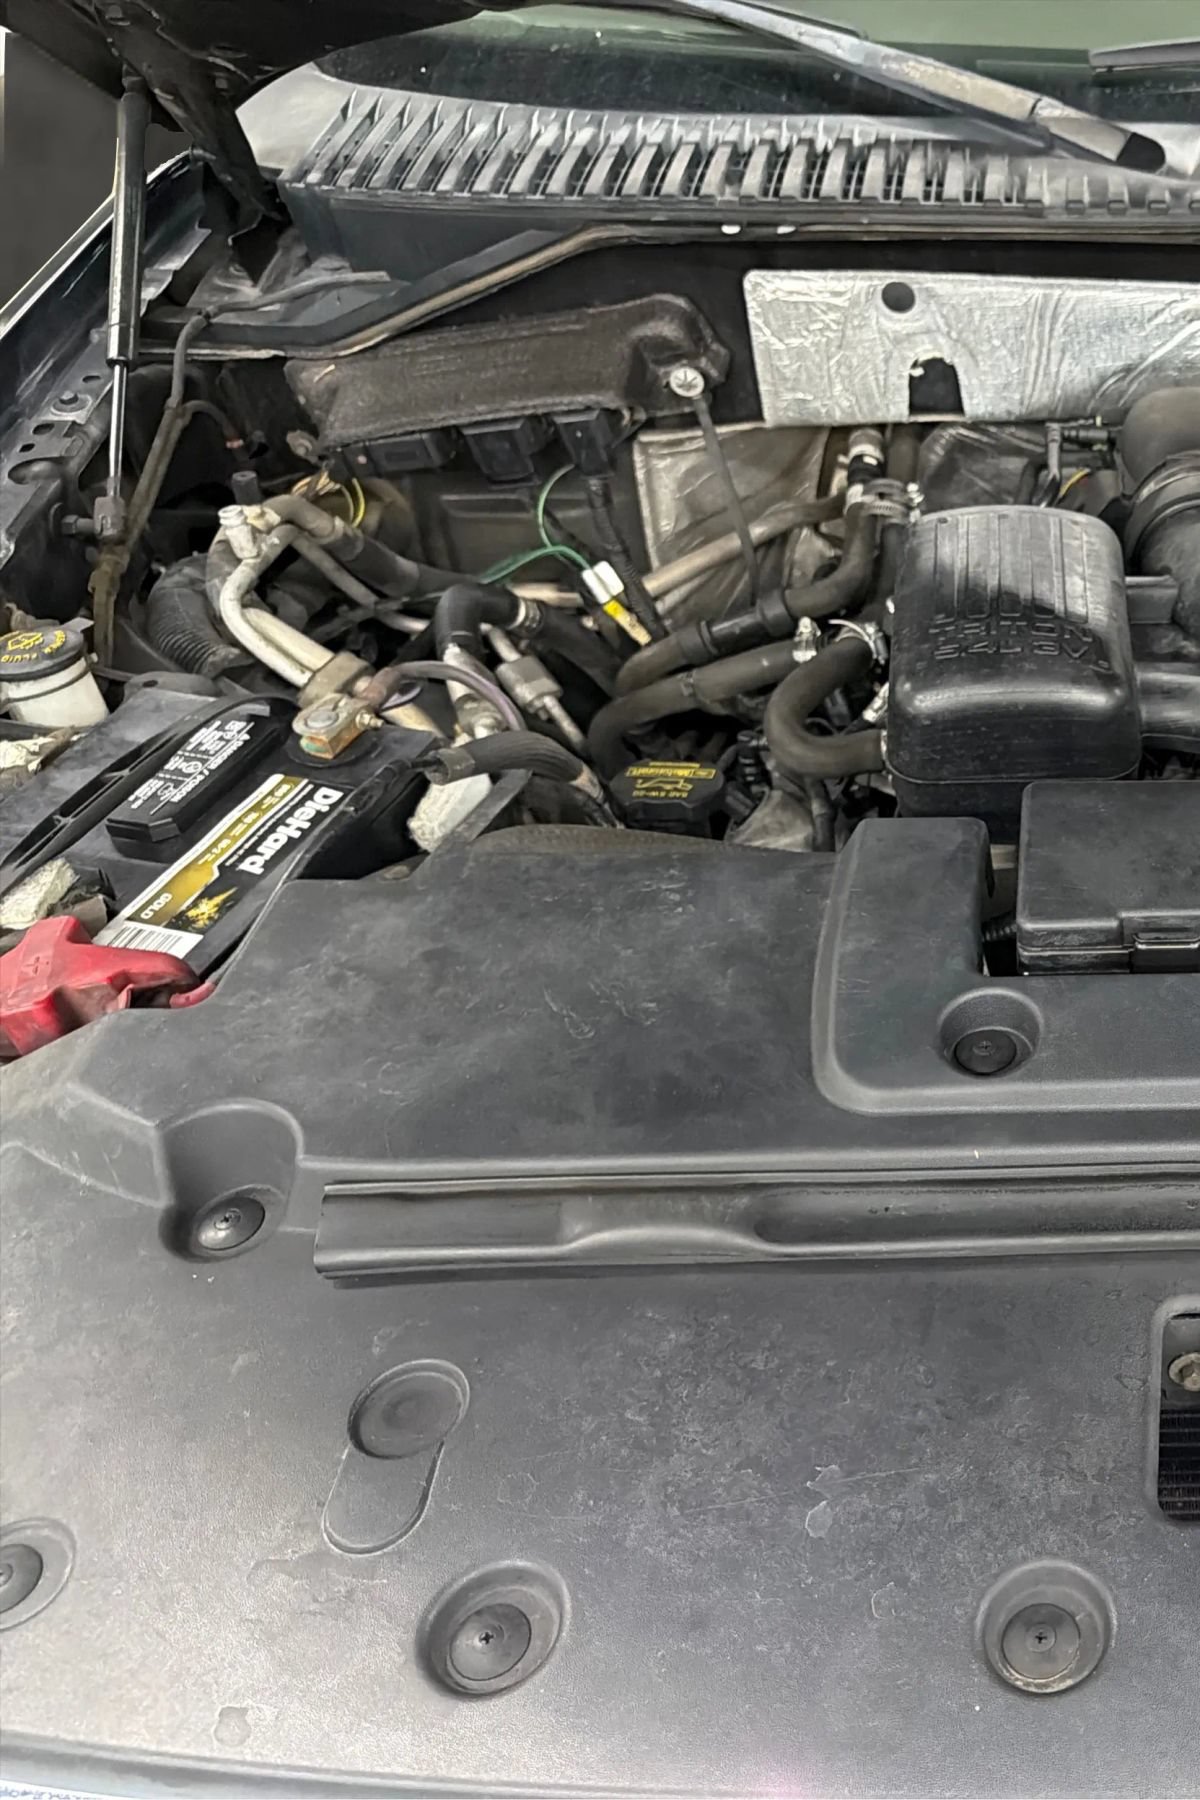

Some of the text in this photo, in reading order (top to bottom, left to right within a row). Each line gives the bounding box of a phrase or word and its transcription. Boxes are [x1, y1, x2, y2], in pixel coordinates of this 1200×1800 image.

[928, 620, 1093, 642] TRITON
[934, 640, 1090, 660] 5.4L 3V
[236, 785, 345, 876] DieHard
[140, 892, 173, 921] GOLD
